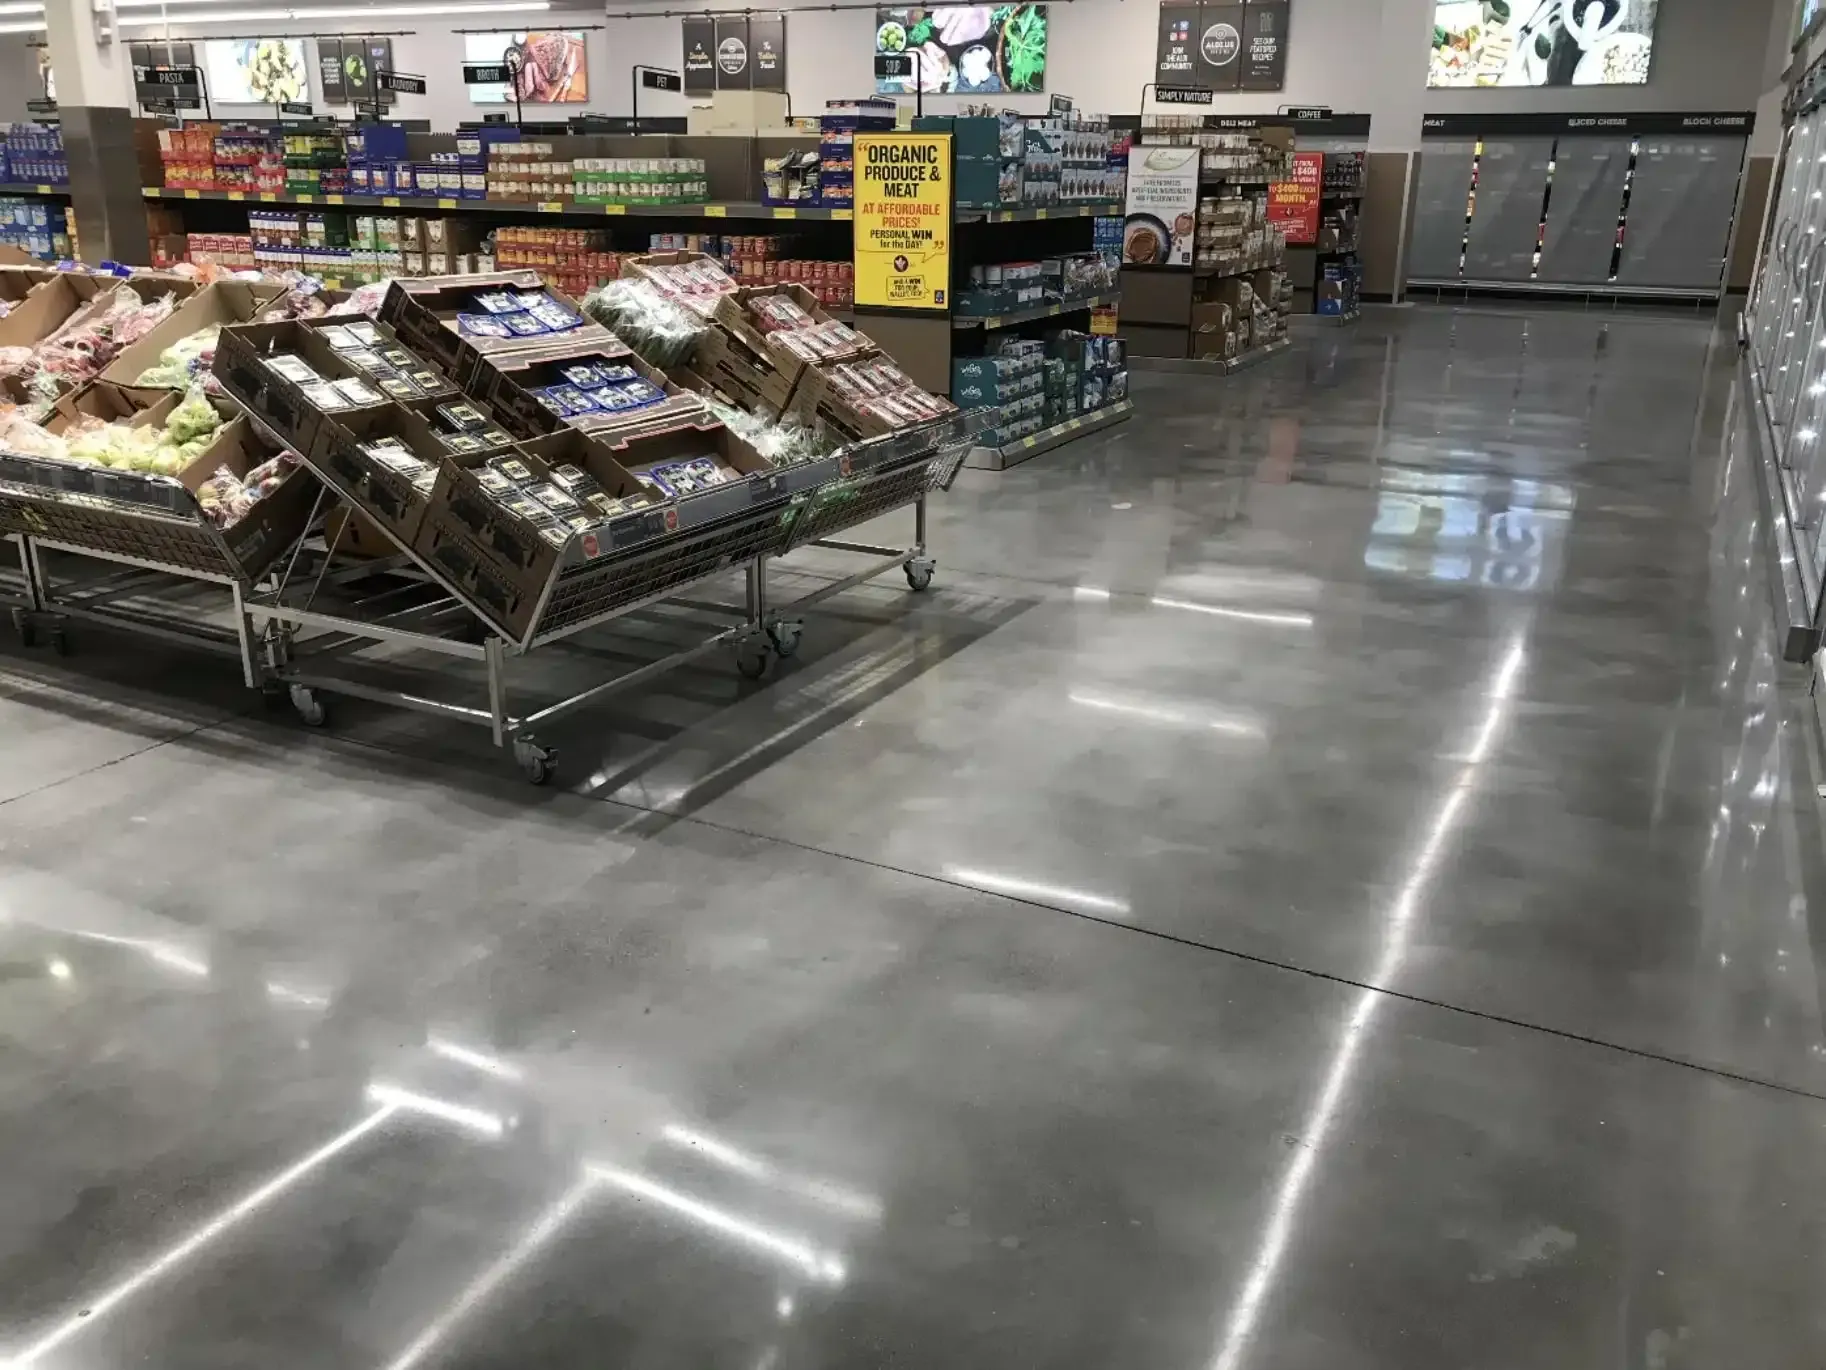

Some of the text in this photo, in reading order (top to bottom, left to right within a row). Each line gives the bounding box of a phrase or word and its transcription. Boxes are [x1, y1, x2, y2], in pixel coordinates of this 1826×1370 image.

[1252, 53, 1274, 61] RECIPES
[1160, 62, 1193, 70] COMMUNITY
[158, 72, 184, 84] PASTA
[476, 68, 500, 81] BROTH
[388, 78, 418, 92] LAUNDRY
[656, 76, 668, 88] PET
[1158, 90, 1212, 102] SIMPLY NATURE
[1298, 110, 1322, 118] COFFEE
[1598, 118, 1628, 126] CHEESE
[1682, 117, 1746, 126] BLOCK CHEESE
[868, 144, 938, 164] ORGANIC
[864, 166, 942, 182] PRODUCE &
[884, 182, 920, 198] MEAT
[1277, 183, 1298, 193] $400
[1275, 194, 1306, 204] MONTH
[862, 203, 940, 216] AT AFFORDABLE
[882, 216, 921, 228] PRICES!
[870, 230, 933, 240] PERSONAL WIN
[880, 240, 890, 248] for
[892, 240, 904, 248] the
